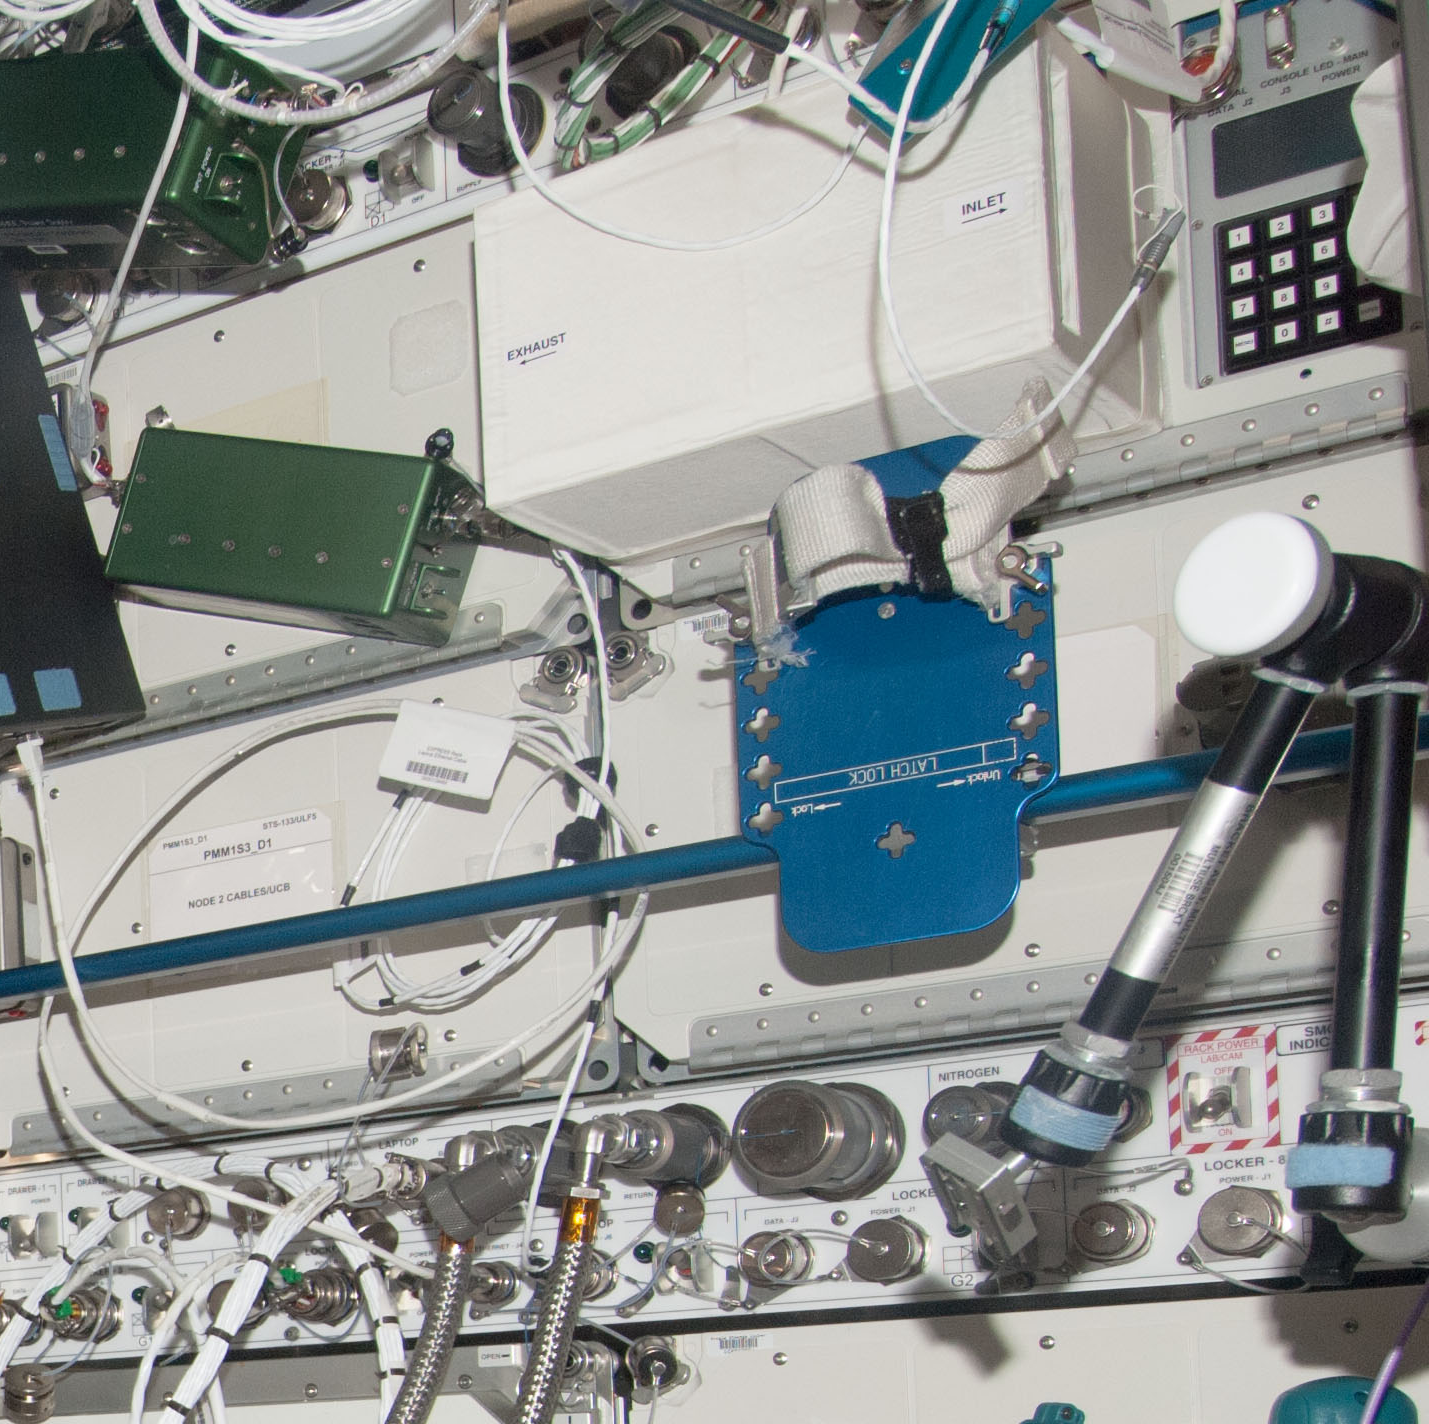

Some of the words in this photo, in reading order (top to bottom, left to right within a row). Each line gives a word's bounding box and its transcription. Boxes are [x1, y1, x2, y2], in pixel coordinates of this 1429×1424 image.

[1260, 66, 1310, 89] CONSOLE
[1313, 63, 1330, 74] LED
[1343, 50, 1369, 66] MAIN
[1280, 86, 1292, 96] J3
[1322, 65, 1361, 83] POWER
[1242, 98, 1254, 108] J2
[962, 192, 1007, 215] INLET
[371, 214, 387, 228] D1
[507, 332, 567, 361] EXHAUST
[891, 757, 938, 777] LATCH
[848, 766, 885, 786] LOCK
[966, 769, 1001, 786] Unlock
[791, 803, 814, 817] Lock
[262, 812, 317, 830] STS-133/ULF5
[203, 838, 273, 861] PMM1S3_D1
[188, 894, 216, 909] NODE
[226, 882, 291, 902] CABLES/UCB
[1184, 1043, 1214, 1054] RACK
[1217, 1038, 1259, 1050] POWER
[1200, 1052, 1243, 1063] LAB/CAM
[938, 1066, 1000, 1082] NITROGEN
[1214, 1066, 1234, 1075] OFF
[1218, 1128, 1233, 1136] ON
[378, 1138, 419, 1149] LAPTOP
[1204, 1157, 1265, 1171] LOCKER
[1219, 1175, 1253, 1184] POWER
[1262, 1173, 1271, 1181] J1
[8, 1185, 37, 1196] DRAWER
[624, 1191, 654, 1200] RETURN
[892, 1188, 936, 1200] LOCKE
[409, 1250, 434, 1258] POWER
[950, 1274, 975, 1288] G2
[480, 1352, 501, 1360] OPEN
